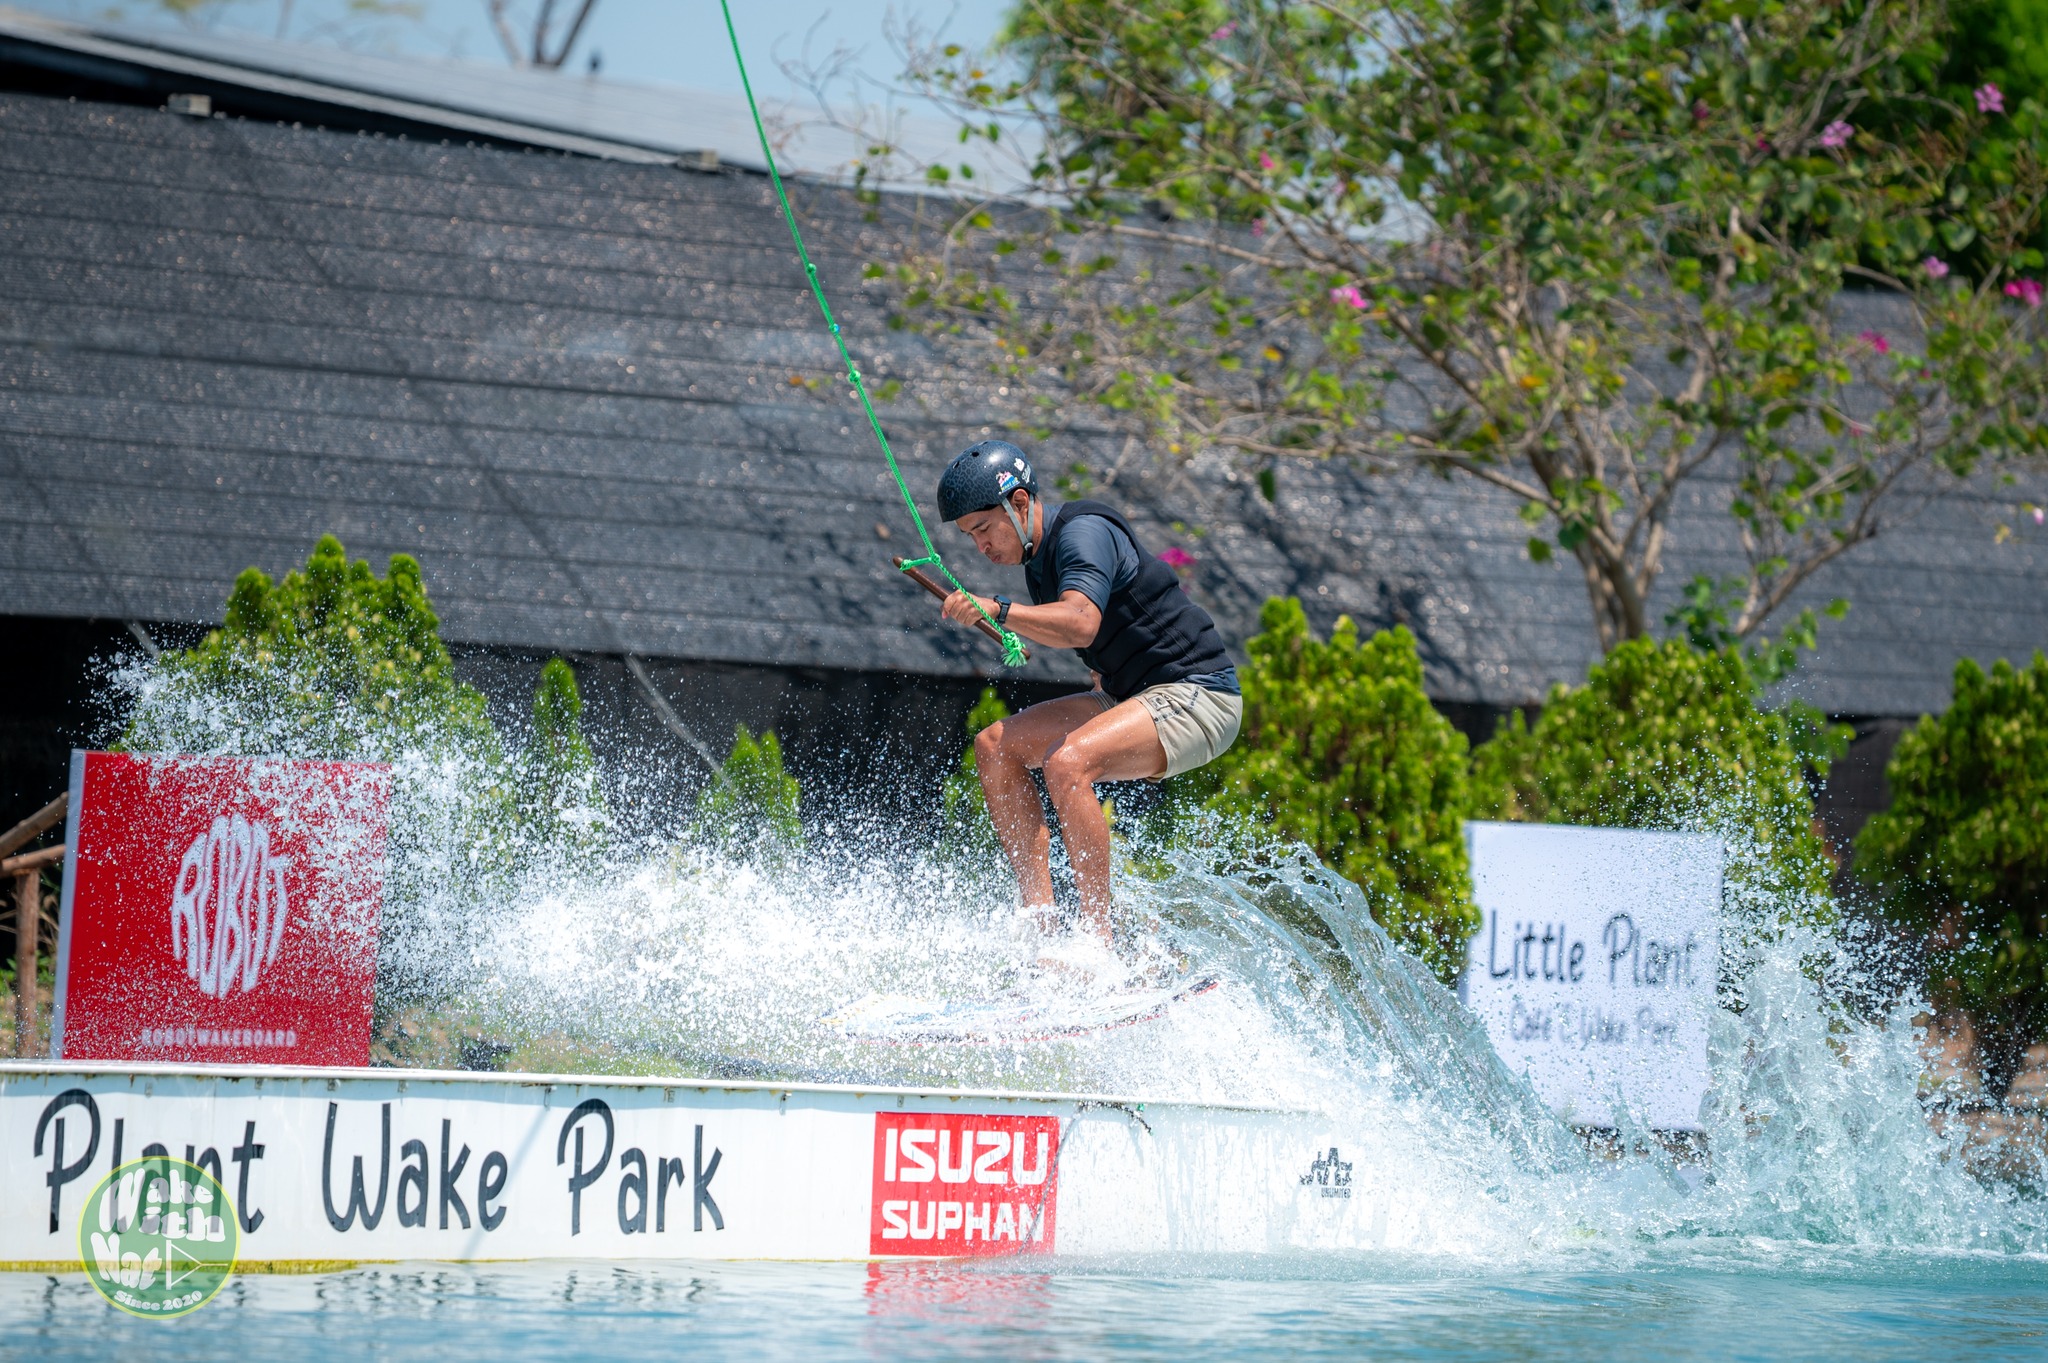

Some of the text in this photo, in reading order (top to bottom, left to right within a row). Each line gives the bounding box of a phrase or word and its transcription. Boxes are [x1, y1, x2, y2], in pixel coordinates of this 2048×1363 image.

[172, 814, 288, 999] ROBOT
[1488, 909, 1584, 982] Little
[33, 1088, 726, 1237] Plant Wake Park
[884, 1128, 1049, 1185] ISUZU
[881, 1200, 1046, 1243] SUPHAN
